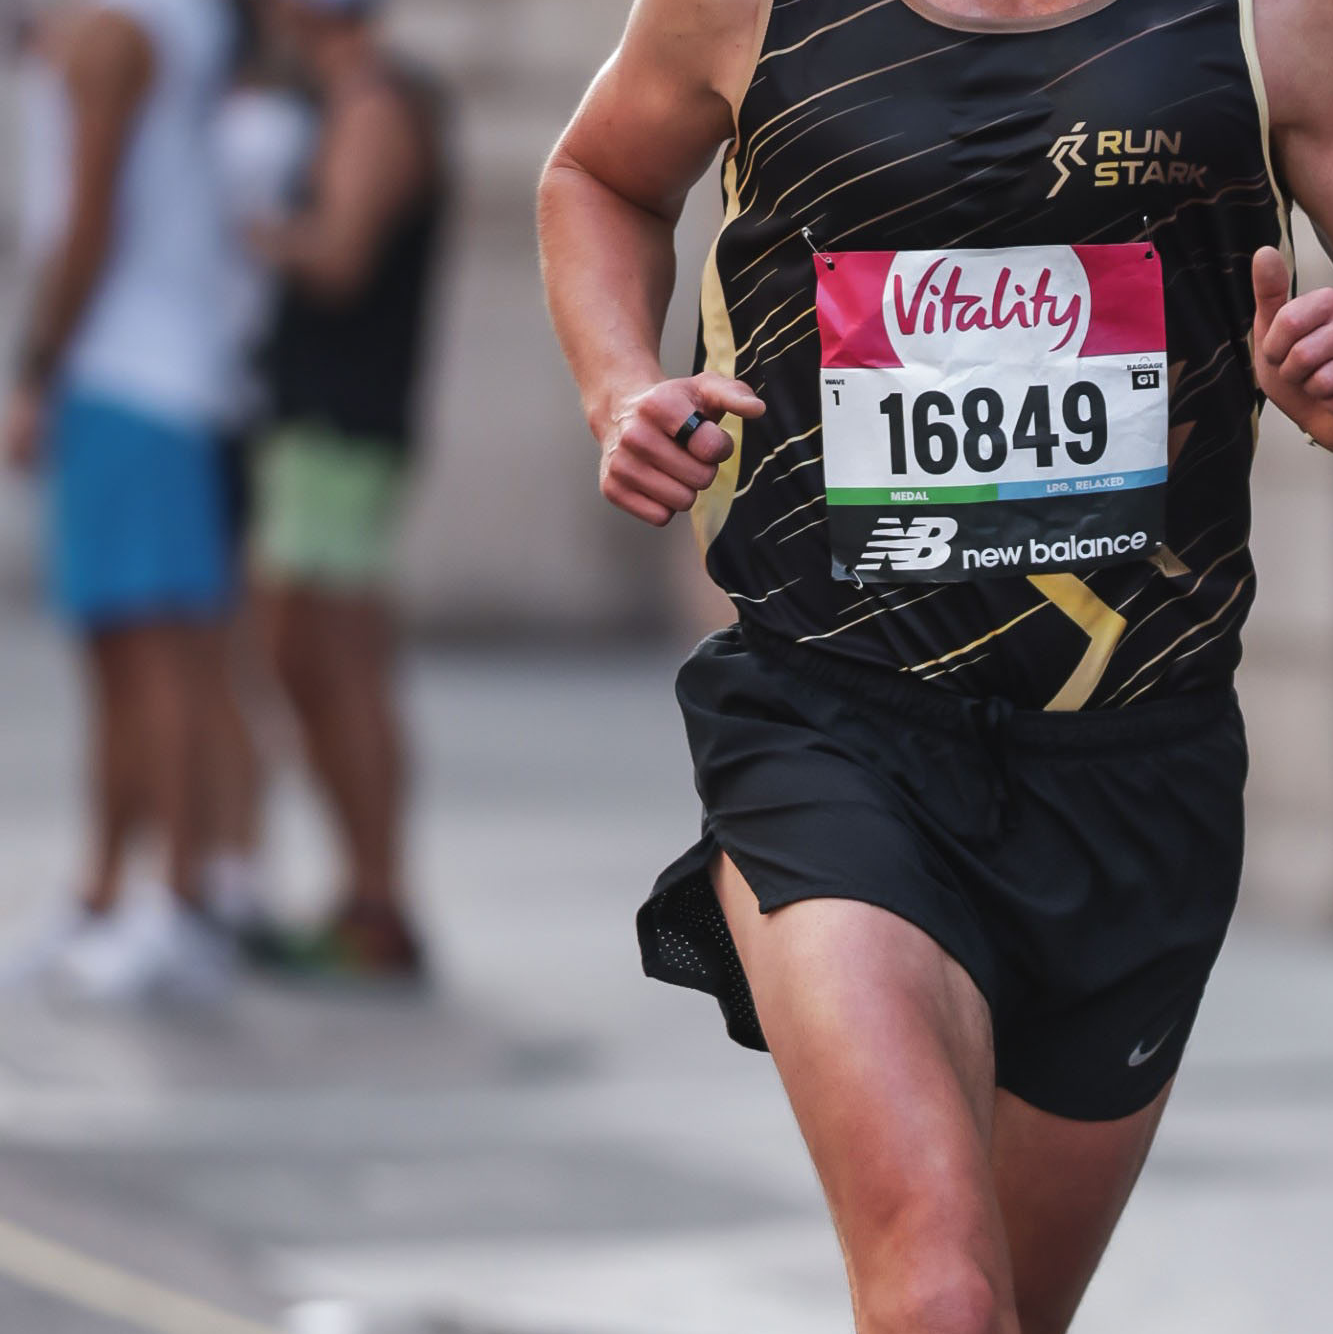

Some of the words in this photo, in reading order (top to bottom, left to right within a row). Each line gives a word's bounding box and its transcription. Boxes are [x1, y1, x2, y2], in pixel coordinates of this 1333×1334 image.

[1097, 129, 1182, 156] RUN
[1094, 159, 1208, 188] STARK
[893, 257, 1082, 353] Vitality
[1137, 373, 1155, 386] G1
[832, 390, 840, 406] 1
[879, 381, 1108, 476] 16849
[890, 491, 929, 501] MEDAL
[1046, 482, 1073, 494] LRG.
[1075, 476, 1125, 491] RELAXED
[962, 545, 1023, 569] new
[1029, 531, 1148, 564] balance
